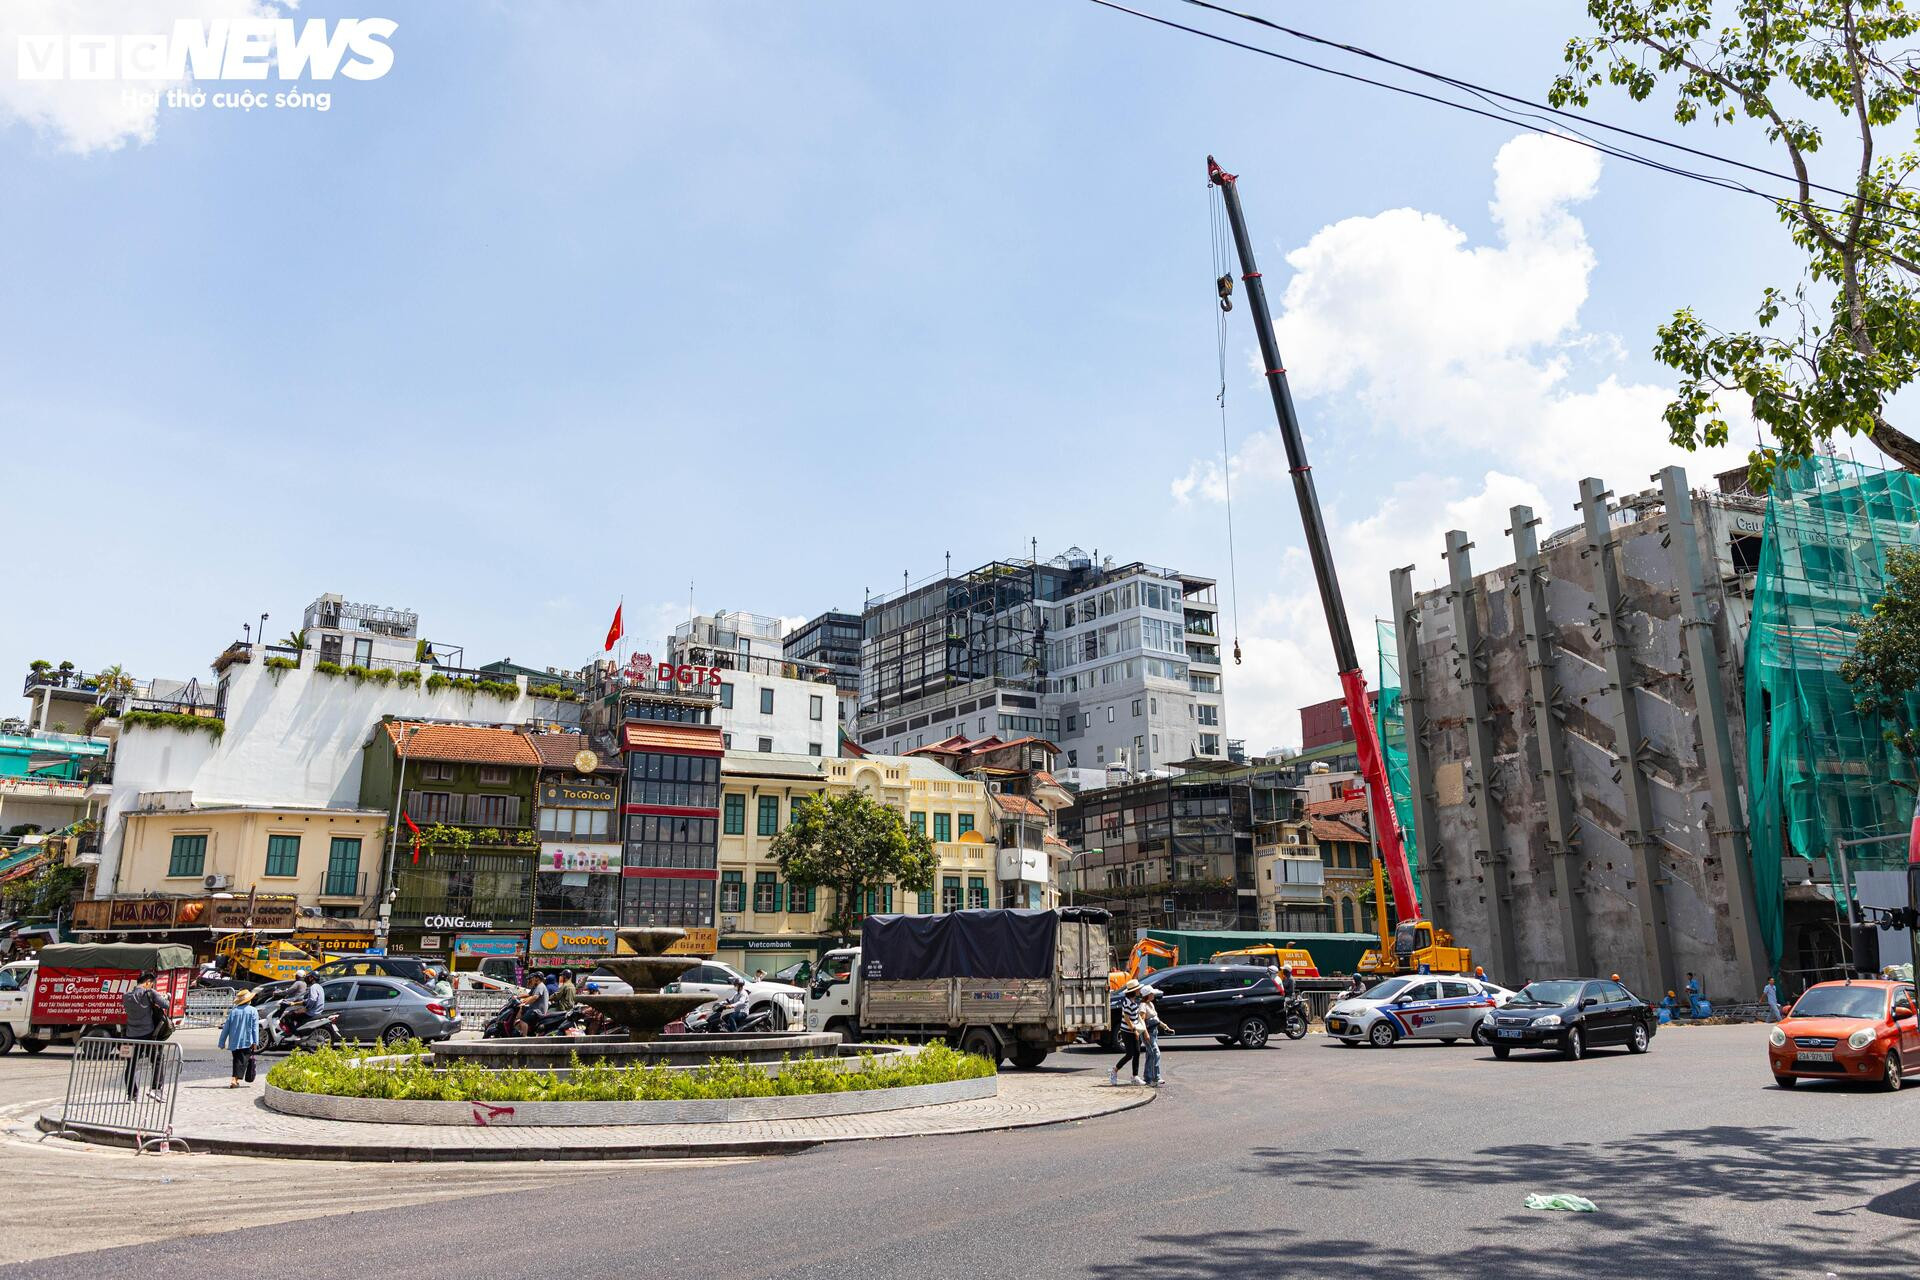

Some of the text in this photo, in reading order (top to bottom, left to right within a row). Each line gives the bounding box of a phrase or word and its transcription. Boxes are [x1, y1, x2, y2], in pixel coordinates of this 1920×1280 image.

[657, 662, 721, 687] DGTS
[424, 914, 465, 930] CỘNG
[391, 943, 404, 951] 116
[748, 940, 792, 948] Vietcombank
